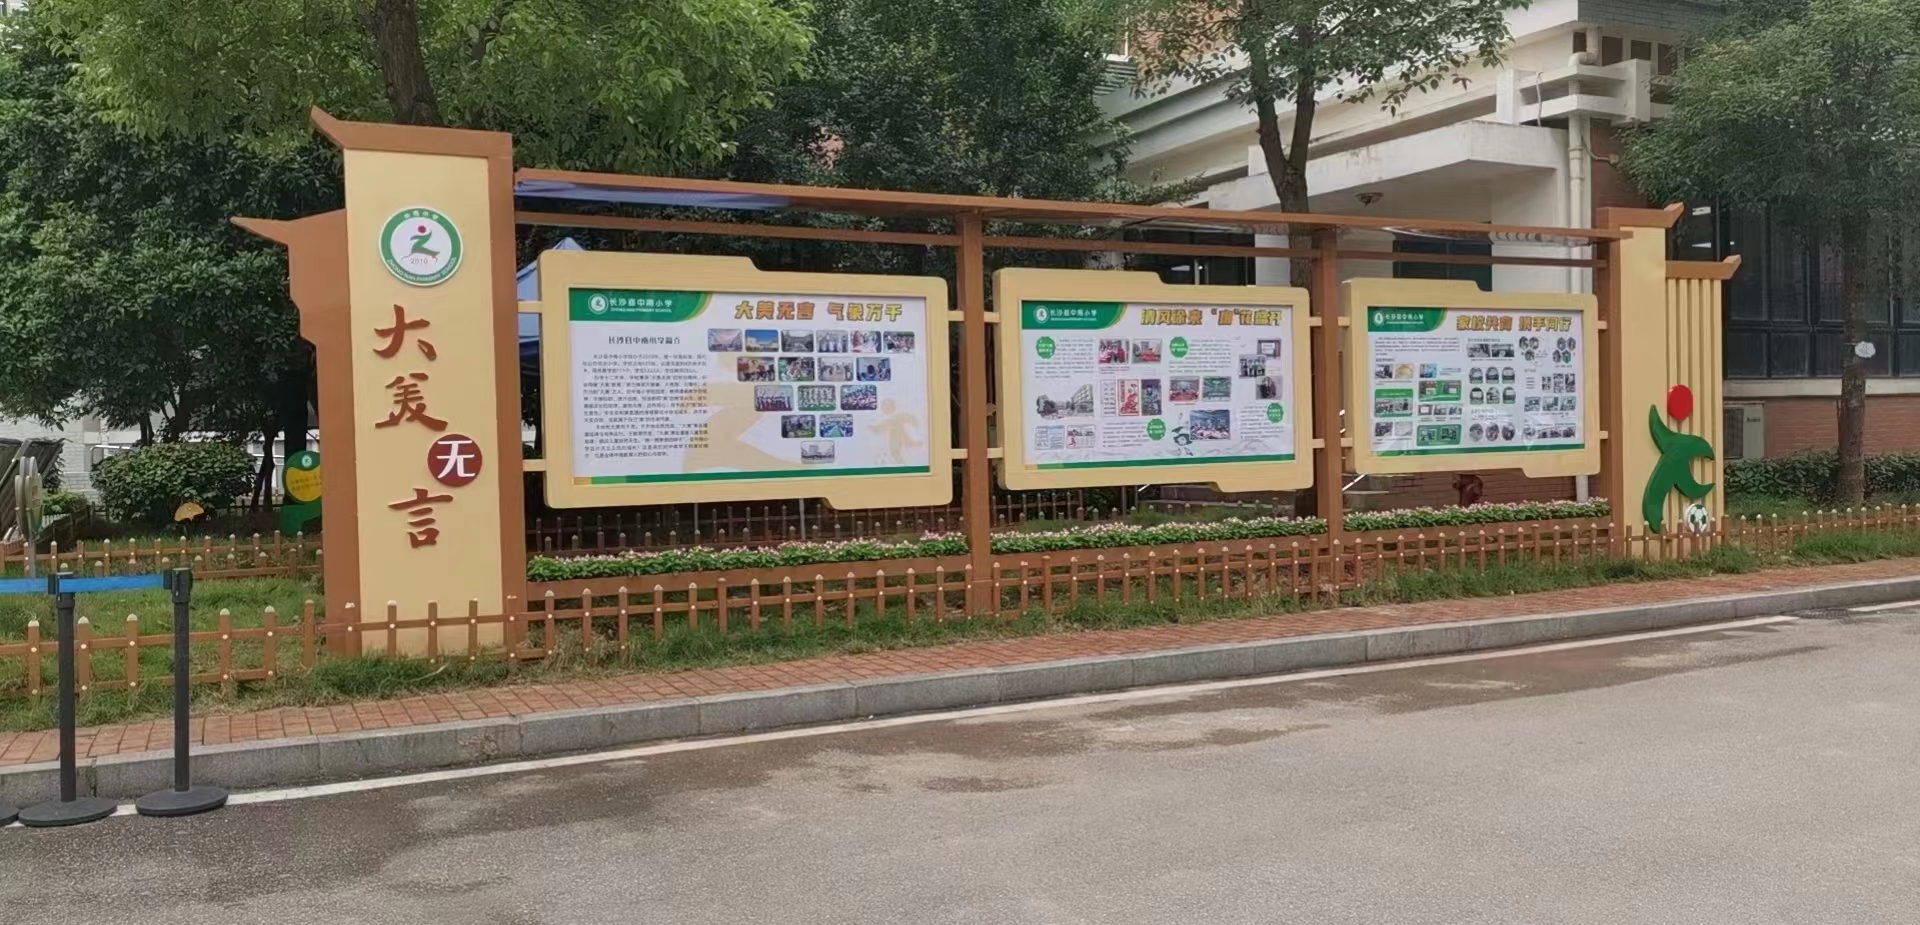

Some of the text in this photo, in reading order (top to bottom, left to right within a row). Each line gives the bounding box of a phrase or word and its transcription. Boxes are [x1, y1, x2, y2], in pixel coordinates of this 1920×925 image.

[610, 298, 673, 307] 长沙县中南小学
[734, 300, 903, 322] 大美无言 气象万千
[1140, 308, 1203, 326] 清风徐来
[1456, 315, 1572, 332] 家校共育 携手同行
[373, 304, 476, 549] 大美无言
